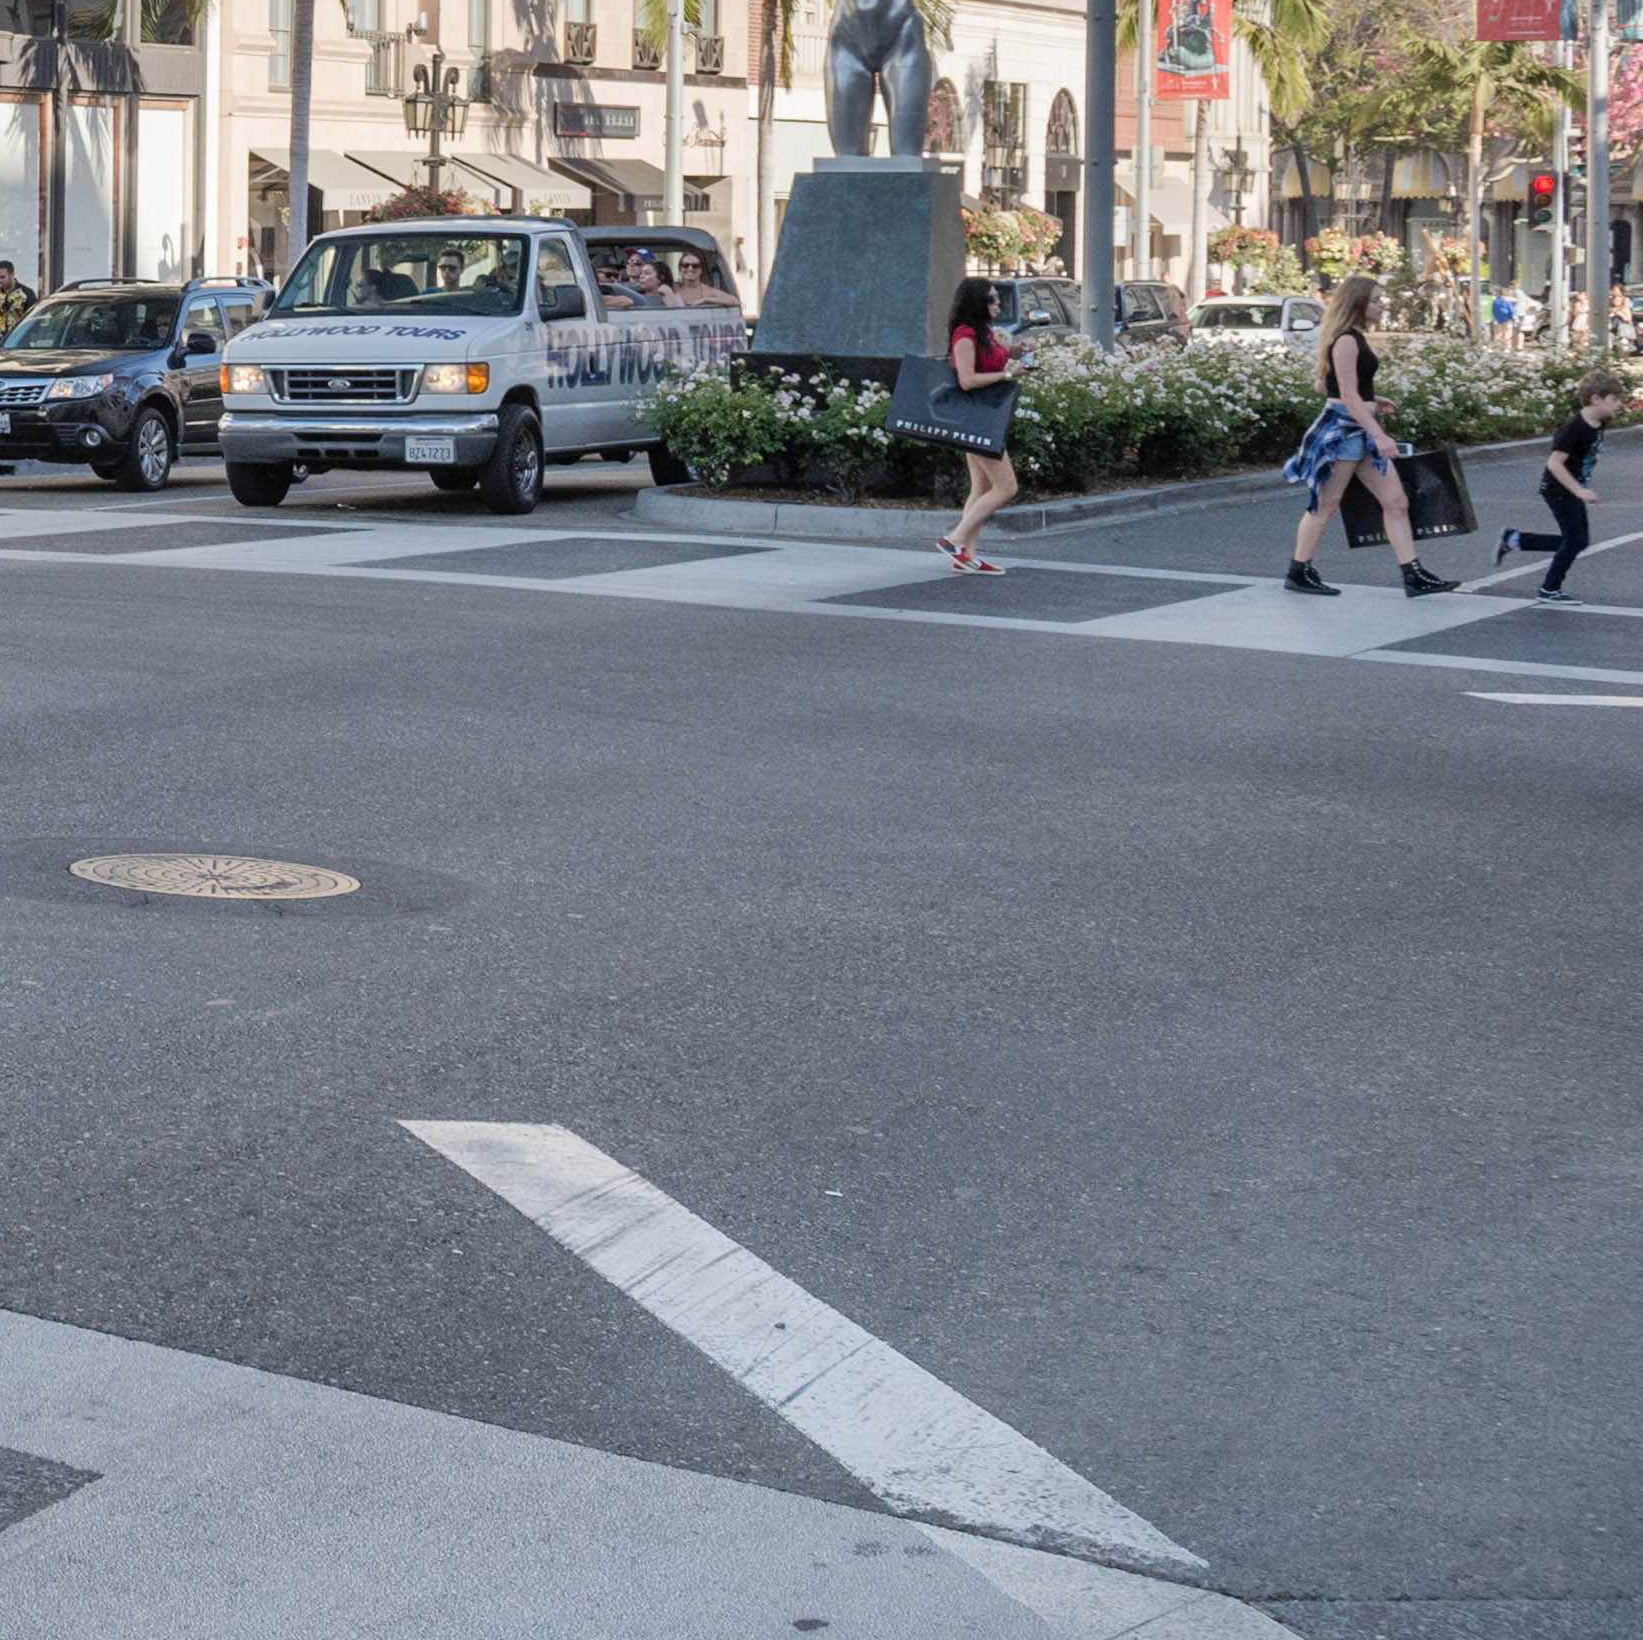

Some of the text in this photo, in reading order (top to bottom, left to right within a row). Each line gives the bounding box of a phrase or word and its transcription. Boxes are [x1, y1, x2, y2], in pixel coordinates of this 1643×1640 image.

[240, 325, 468, 342] HOLLYWOOD TOURS
[896, 419, 992, 446] PHILIPP PLEIN
